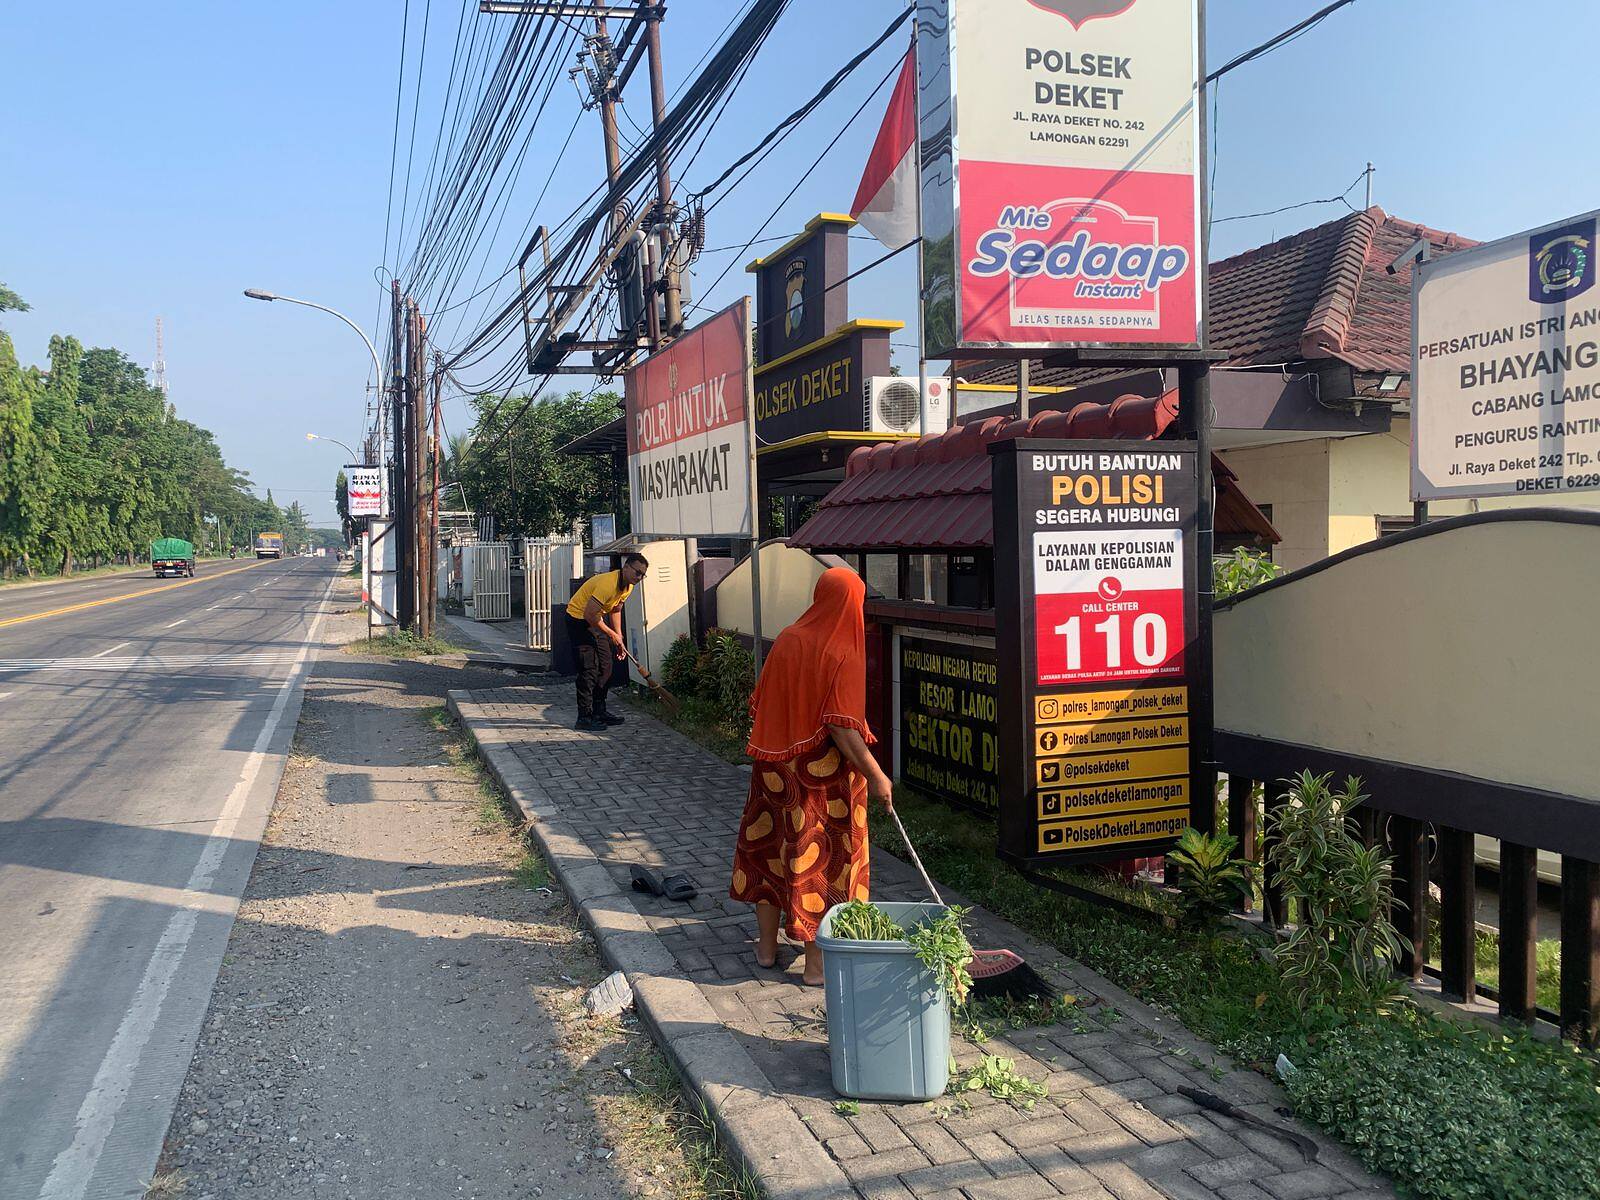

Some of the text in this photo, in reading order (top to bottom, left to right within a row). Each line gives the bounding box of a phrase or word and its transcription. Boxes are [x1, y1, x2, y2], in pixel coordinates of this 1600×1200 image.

[1025, 47, 1132, 79] POLSEK
[1035, 81, 1124, 110] DEKET
[1013, 111, 1145, 131] JL. RAYA DEKET NO. 242
[1030, 131, 1129, 148] LAMONGAN 62291
[1000, 206, 1051, 229] Mie
[971, 231, 1187, 289] Sedaap
[1075, 281, 1142, 298] Instant
[1018, 313, 1153, 327] JELAS TERASA SEDAPNYA
[1419, 326, 1514, 361] PERSATUAN
[1520, 315, 1565, 340] ISTRI
[1460, 341, 1598, 389] BHAYANG
[755, 357, 852, 422] OLSEK DEKET
[636, 373, 729, 449] POLRI UNTUK
[1472, 391, 1545, 417] CABANG
[1455, 426, 1538, 449] PENGURUS
[638, 443, 731, 502] MASYARAKAT
[1032, 454, 1182, 471] BUTUH BANTUAN
[1449, 463, 1462, 476] Jl.
[1466, 461, 1495, 476] Raya
[1500, 456, 1536, 473] Deket
[1539, 453, 1563, 469] 242
[1567, 452, 1593, 467] Tlp.
[1052, 474, 1164, 506] POLISI
[1516, 475, 1563, 492] DEKET
[1036, 507, 1180, 525] SEGERA HUBUNGI
[1038, 541, 1175, 558] LAYANAN KEPOLISIAN
[1046, 556, 1172, 573] DALAM GENGGAMAN
[1082, 601, 1139, 613] CALL CENTER
[1054, 612, 1168, 671] 110
[904, 650, 998, 685] KEPOLISIAN NEGARA REPUB
[920, 680, 998, 724] RESOR LAMO
[1062, 692, 1183, 717] polres_lamongan_polsek_deket
[908, 712, 999, 776] SEKTOR D
[1063, 724, 1183, 746] Polres Lamongan Polsek Deket
[906, 757, 926, 779] Jalan
[926, 764, 945, 791] Raya
[946, 770, 969, 797] Deket
[1064, 758, 1130, 779] @polsekdeket
[1064, 783, 1183, 812] polsekdeketlamongan
[1065, 815, 1188, 844] PolsekDeketLamongan
